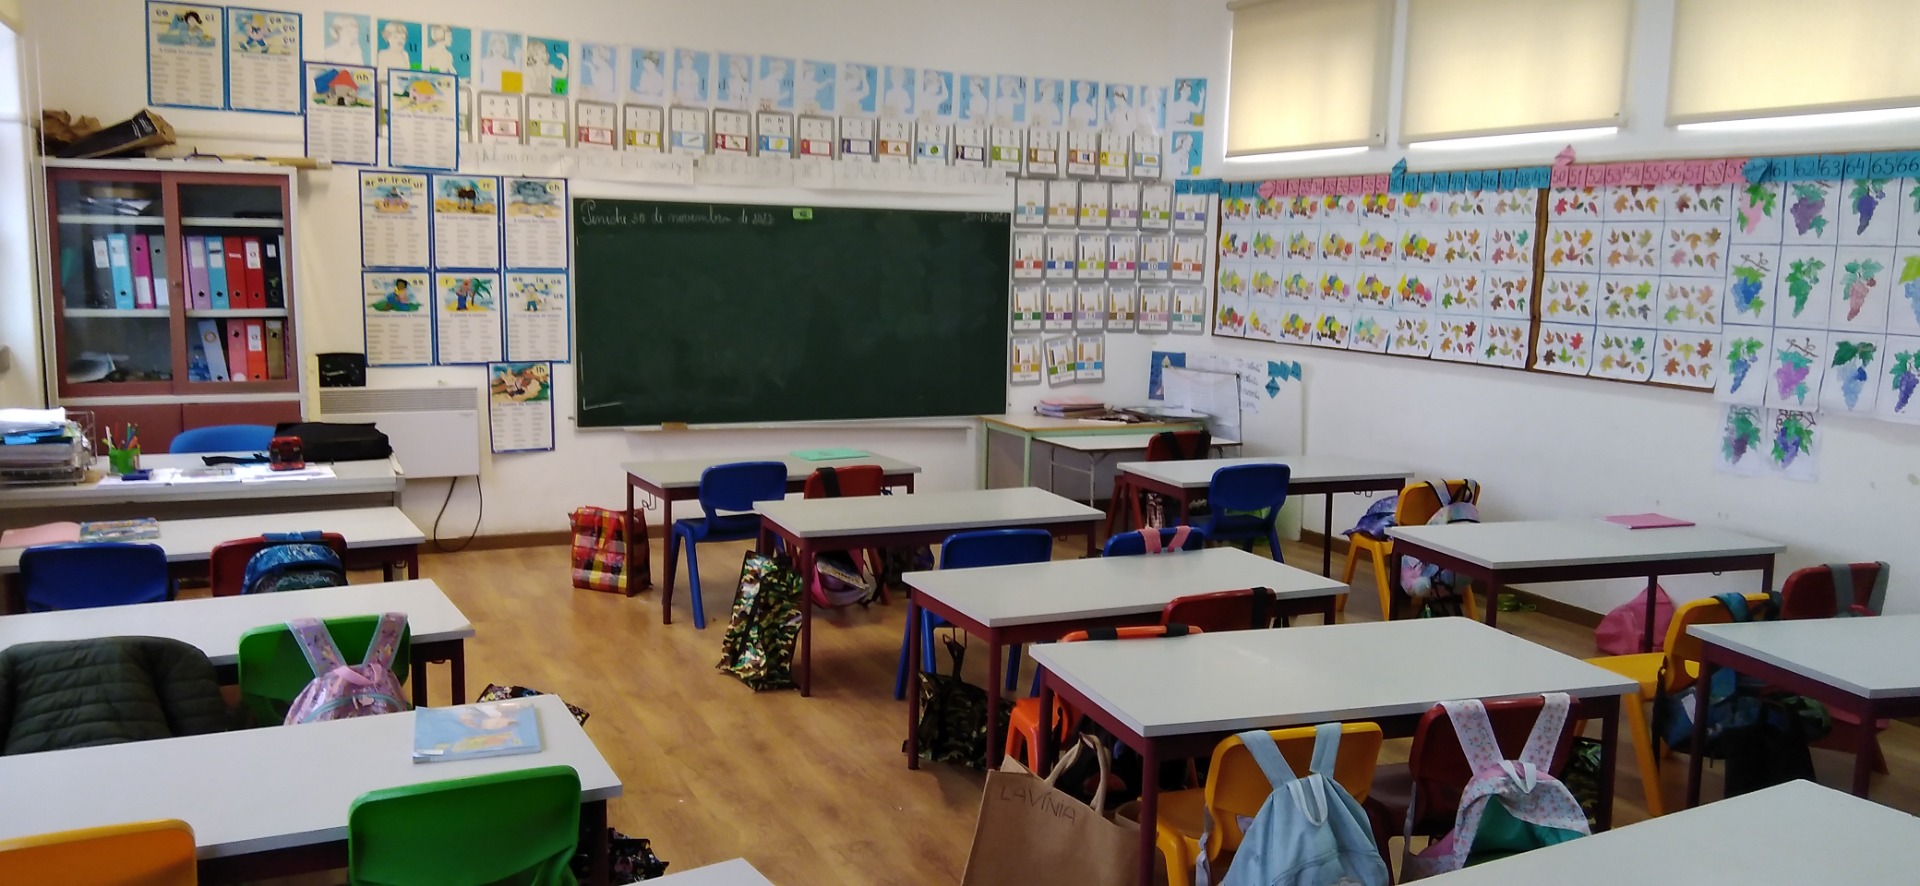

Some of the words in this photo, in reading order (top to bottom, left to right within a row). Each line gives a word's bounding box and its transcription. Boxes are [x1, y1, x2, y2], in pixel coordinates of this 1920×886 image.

[356, 73, 370, 82] nh
[1451, 173, 1463, 190] 44
[1483, 173, 1497, 189] 46
[1501, 172, 1513, 189] 47
[1518, 171, 1530, 187] 48
[1552, 169, 1566, 184] 50
[1569, 169, 1582, 185] 51
[1588, 168, 1603, 184] 52
[1606, 167, 1622, 183] 53
[1624, 166, 1640, 182] 54
[1644, 165, 1661, 182] 55
[1663, 164, 1681, 180] 56
[1684, 164, 1702, 181] 57
[1772, 160, 1788, 177] 61
[1796, 159, 1816, 177] 62
[1820, 158, 1841, 177] 63
[1846, 157, 1866, 176] 64
[1871, 157, 1895, 175] 65
[1896, 156, 1920, 173] 66
